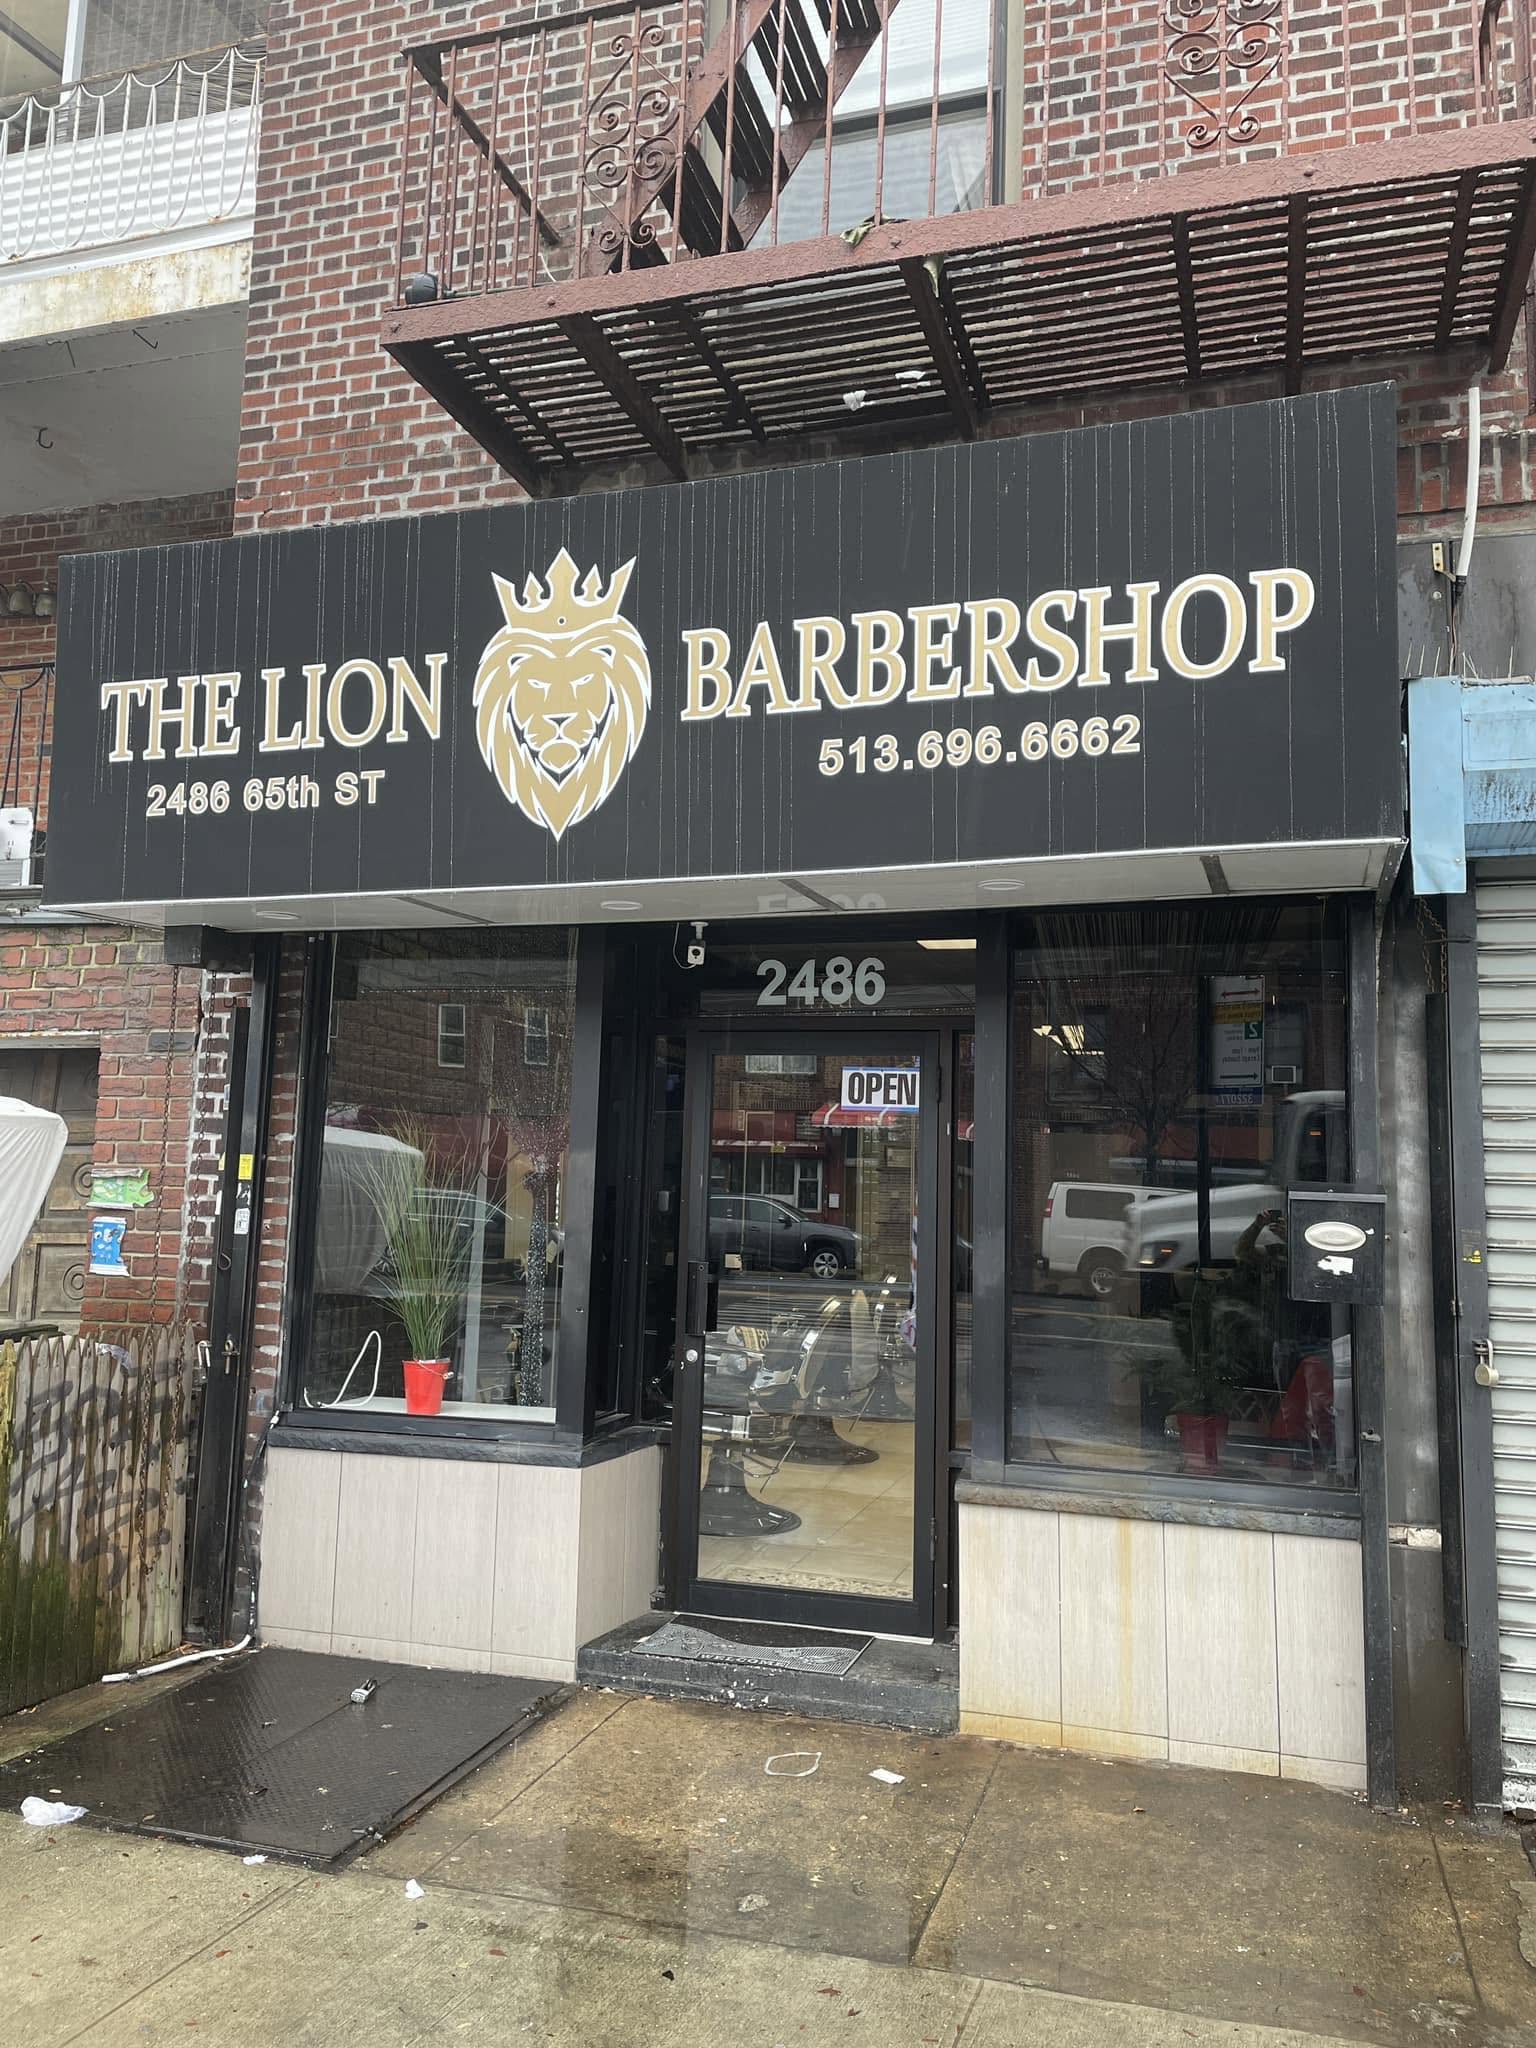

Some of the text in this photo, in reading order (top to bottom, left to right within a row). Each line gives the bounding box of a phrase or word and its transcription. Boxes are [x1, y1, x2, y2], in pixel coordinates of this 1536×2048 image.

[100, 567, 1316, 763] THE LION BARBERSHOP
[817, 714, 1143, 777] 513.696.6662
[146, 769, 386, 818] 2486 65th ST
[756, 956, 887, 1006] 2486
[847, 1071, 917, 1105] OPEN
